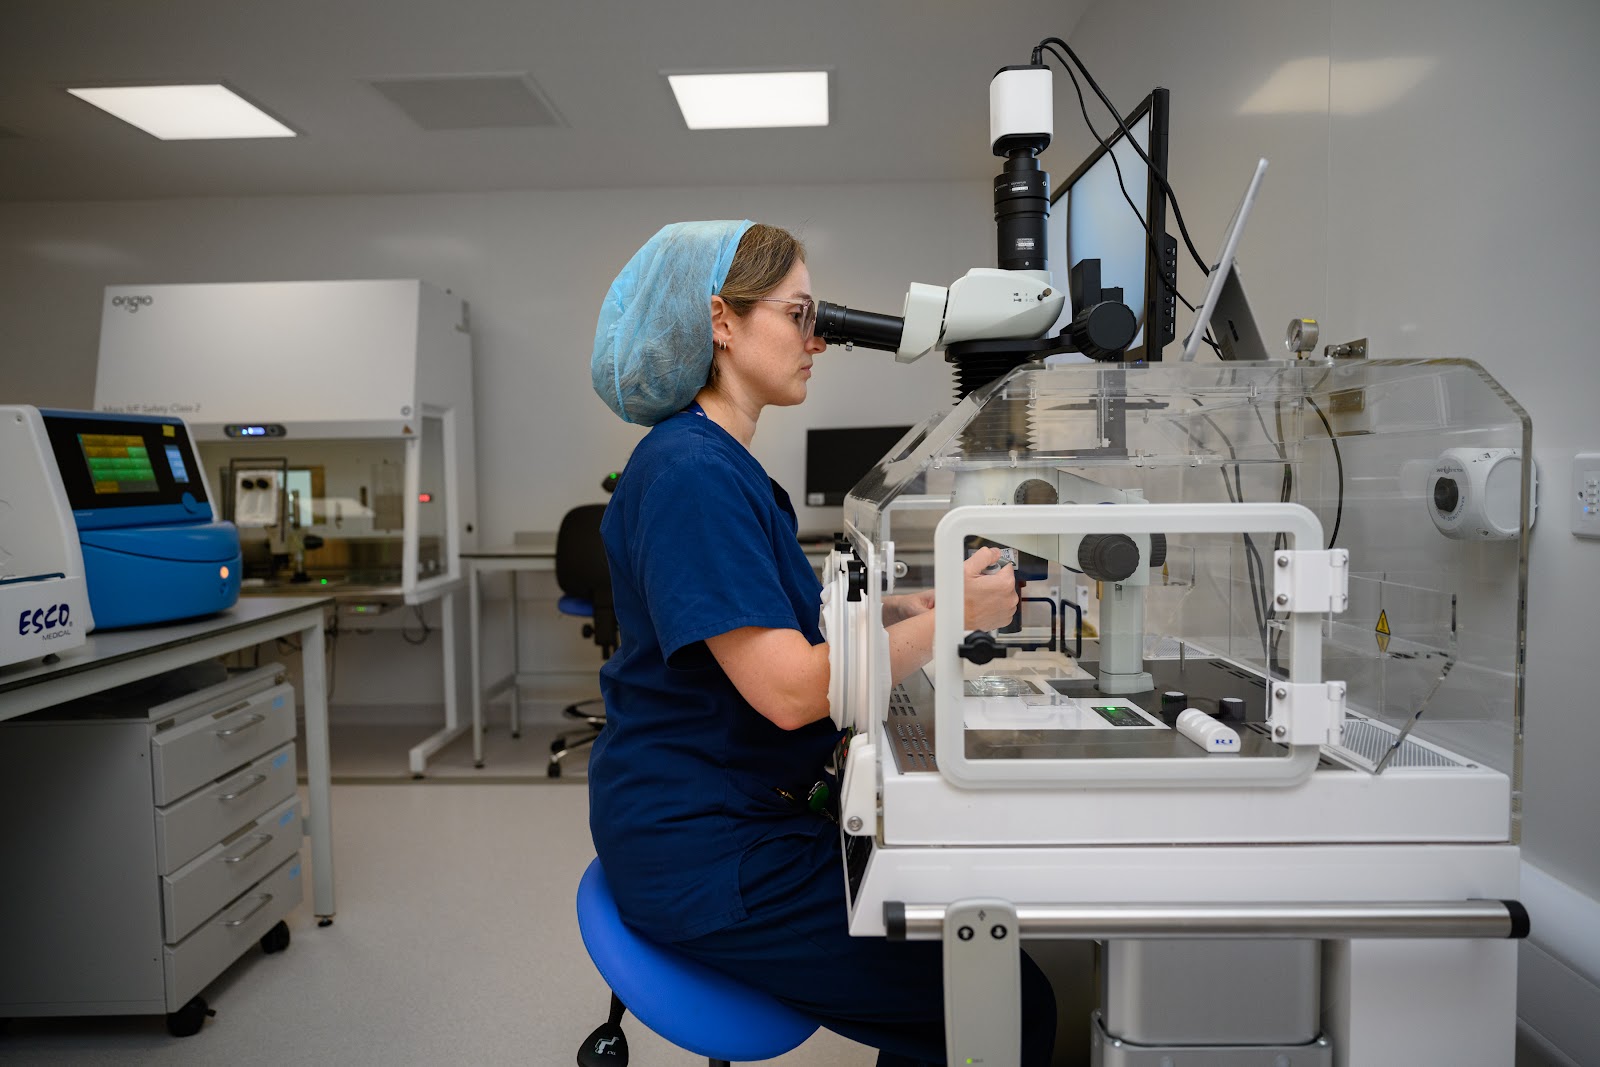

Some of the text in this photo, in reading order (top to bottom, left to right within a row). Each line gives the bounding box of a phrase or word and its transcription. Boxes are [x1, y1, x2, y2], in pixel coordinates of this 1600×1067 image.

[112, 295, 154, 314] origio
[19, 604, 70, 635] ESCO
[42, 630, 71, 640] MEDICAL
